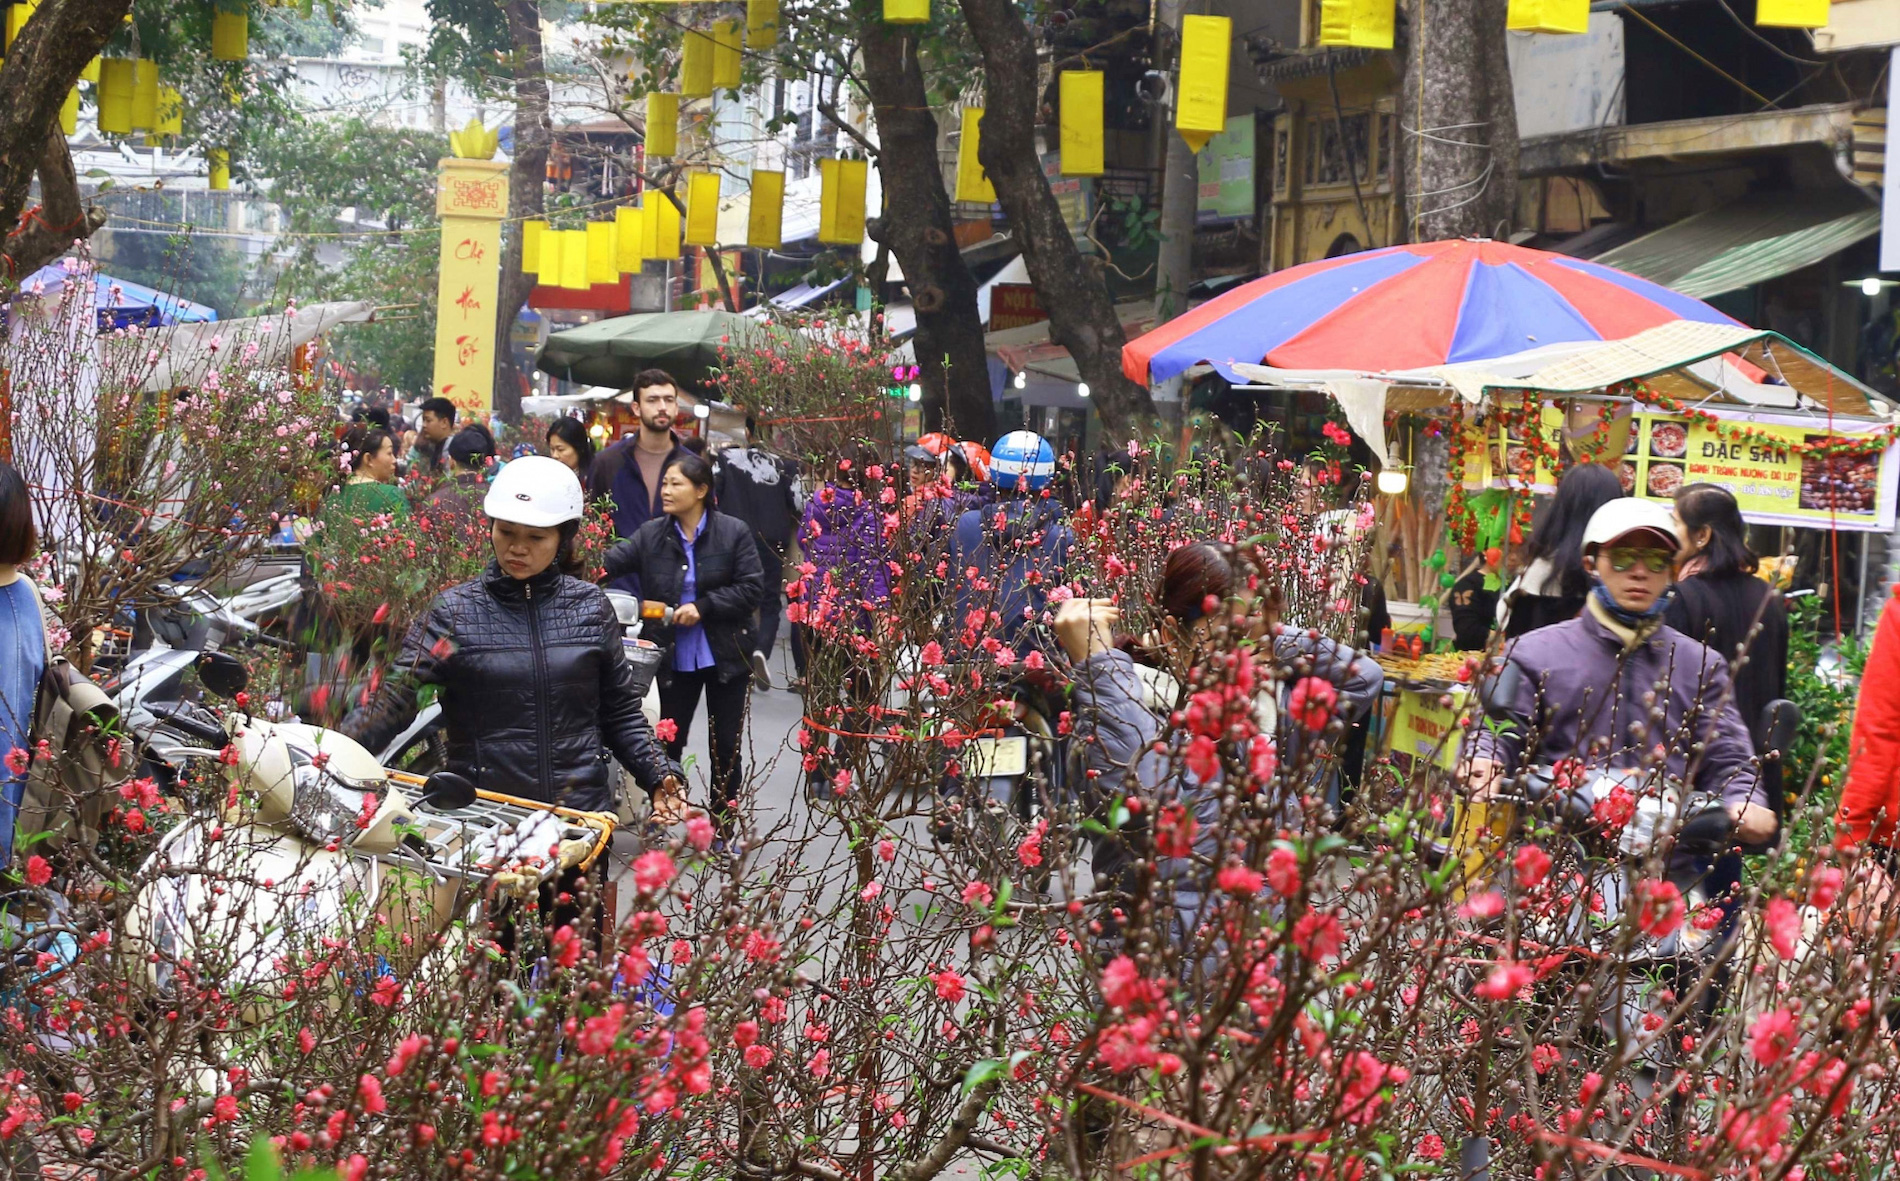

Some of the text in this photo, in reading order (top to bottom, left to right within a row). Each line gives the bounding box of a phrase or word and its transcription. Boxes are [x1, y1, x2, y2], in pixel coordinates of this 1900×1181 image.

[455, 283, 480, 320] Hoa
[456, 334, 479, 366] Tết
[1702, 439, 1742, 462] ĐẶC
